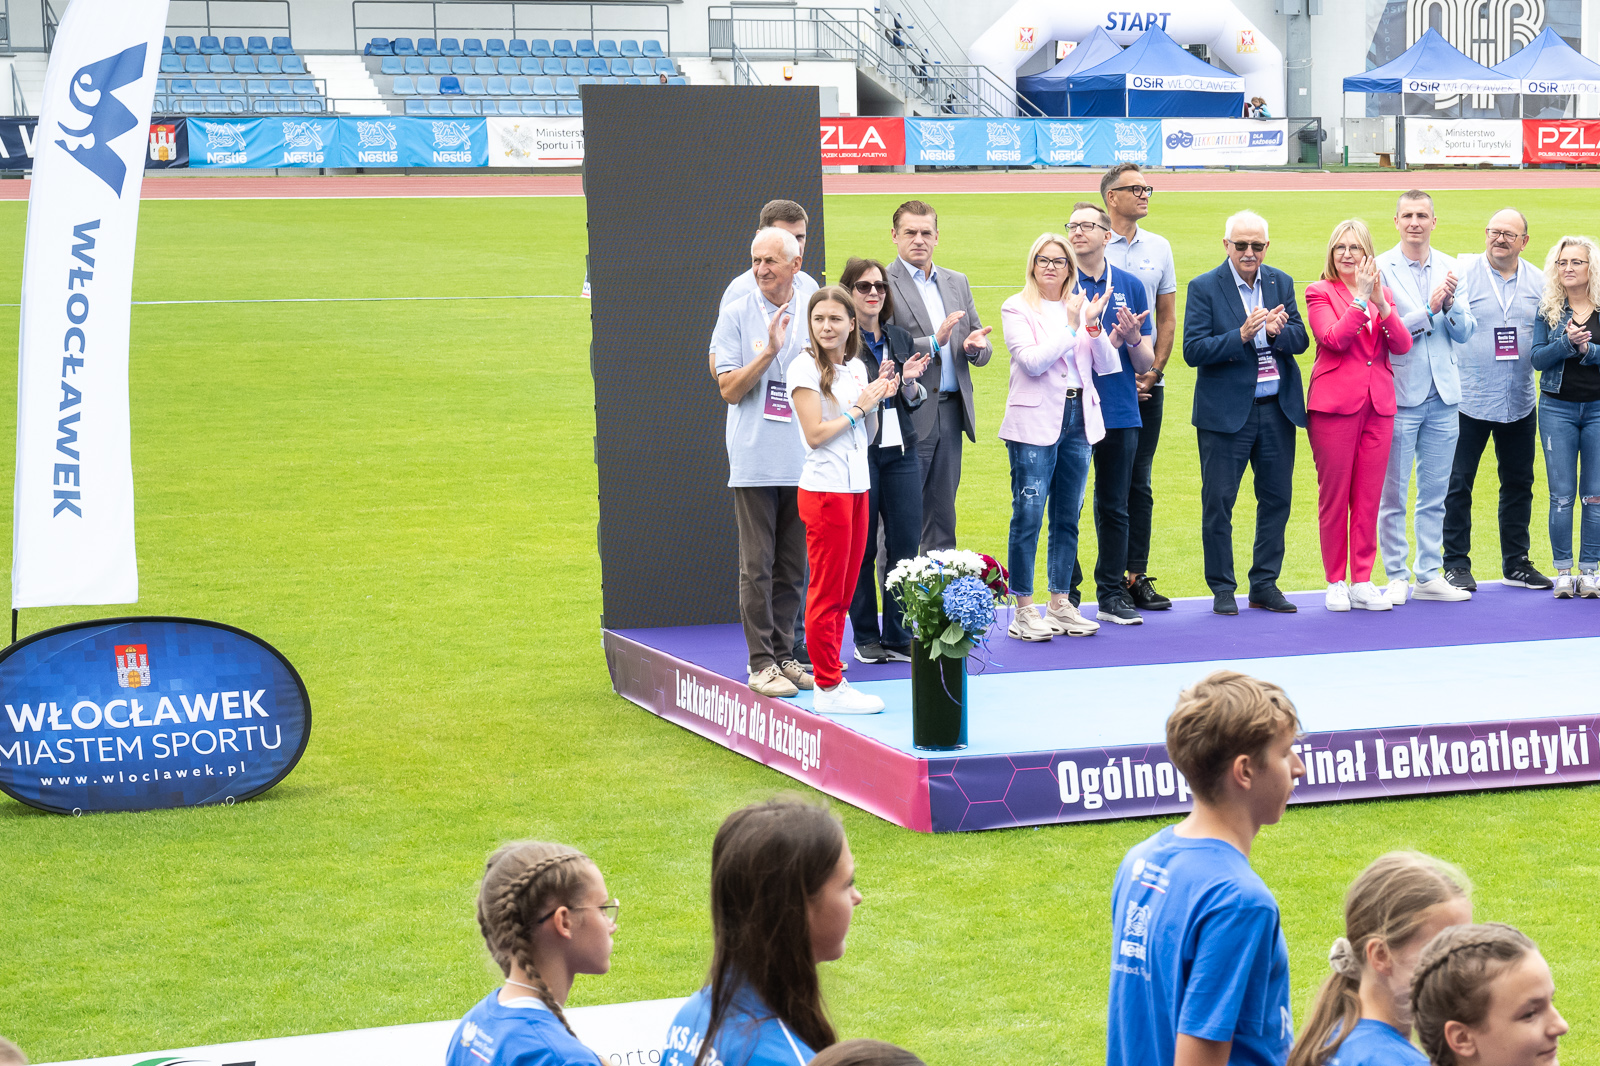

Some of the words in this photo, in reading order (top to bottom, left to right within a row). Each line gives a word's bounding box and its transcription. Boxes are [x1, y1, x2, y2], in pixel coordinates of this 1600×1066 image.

[1105, 11, 1171, 32] START
[1167, 79, 1237, 91] WŁOCŁAWEK
[1443, 82, 1514, 93] WŁOCŁAWEK
[536, 128, 585, 138] Ministerst
[820, 126, 887, 149] ZLA
[1445, 128, 1496, 137] Ministerstwo
[536, 139, 568, 152] Sportu
[1445, 140, 1471, 150] Sportu
[1478, 140, 1512, 150] Turystyki
[52, 218, 101, 518] WŁOCŁAWEK
[4, 689, 270, 733] WŁOCŁAWEK
[675, 668, 748, 737] Lekkoatletyka
[748, 701, 767, 744] dla
[768, 708, 822, 772] każdego!
[0, 735, 144, 766] MIASTEM
[152, 724, 283, 760] SPORTU
[40, 761, 247, 787] www.wloclawek.pl
[1057, 755, 1194, 811] Ogólnop
[1294, 738, 1367, 786] inał
[1375, 723, 1591, 782] Lekkoatletyki
